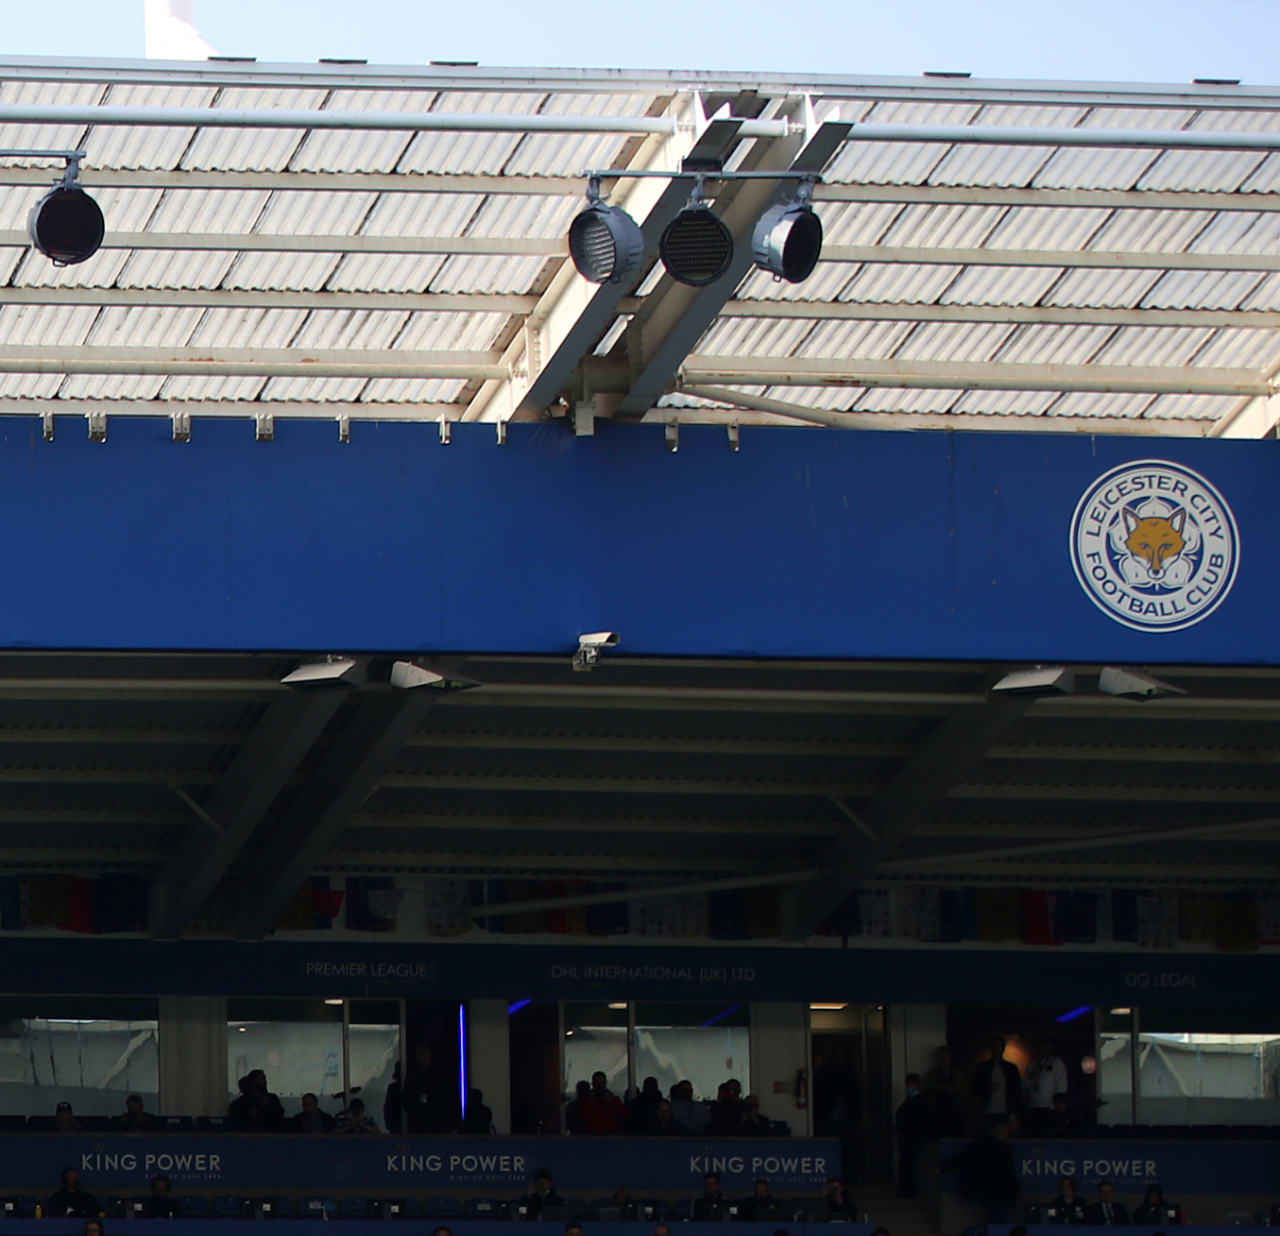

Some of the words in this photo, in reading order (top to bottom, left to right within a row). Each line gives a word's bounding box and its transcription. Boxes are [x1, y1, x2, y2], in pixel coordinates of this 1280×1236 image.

[1086, 474, 1189, 538] LEICESTER
[1190, 493, 1225, 541] CITY
[1086, 551, 1186, 617] FOOTBALL
[1186, 552, 1225, 606] CLUB
[306, 962, 367, 976] PREMIER
[371, 963, 427, 977] LEAGUE
[551, 965, 580, 979] DHL
[584, 965, 694, 981] INTERNATIONAL
[731, 967, 756, 981] LTD
[81, 1154, 137, 1170] KING
[145, 1154, 221, 1171] POWER
[387, 1155, 442, 1171] KING
[450, 1155, 525, 1171] POWER
[689, 1156, 744, 1173] KING
[752, 1157, 826, 1173] POWER
[1022, 1160, 1076, 1176] KING
[1083, 1160, 1157, 1176] POWER
